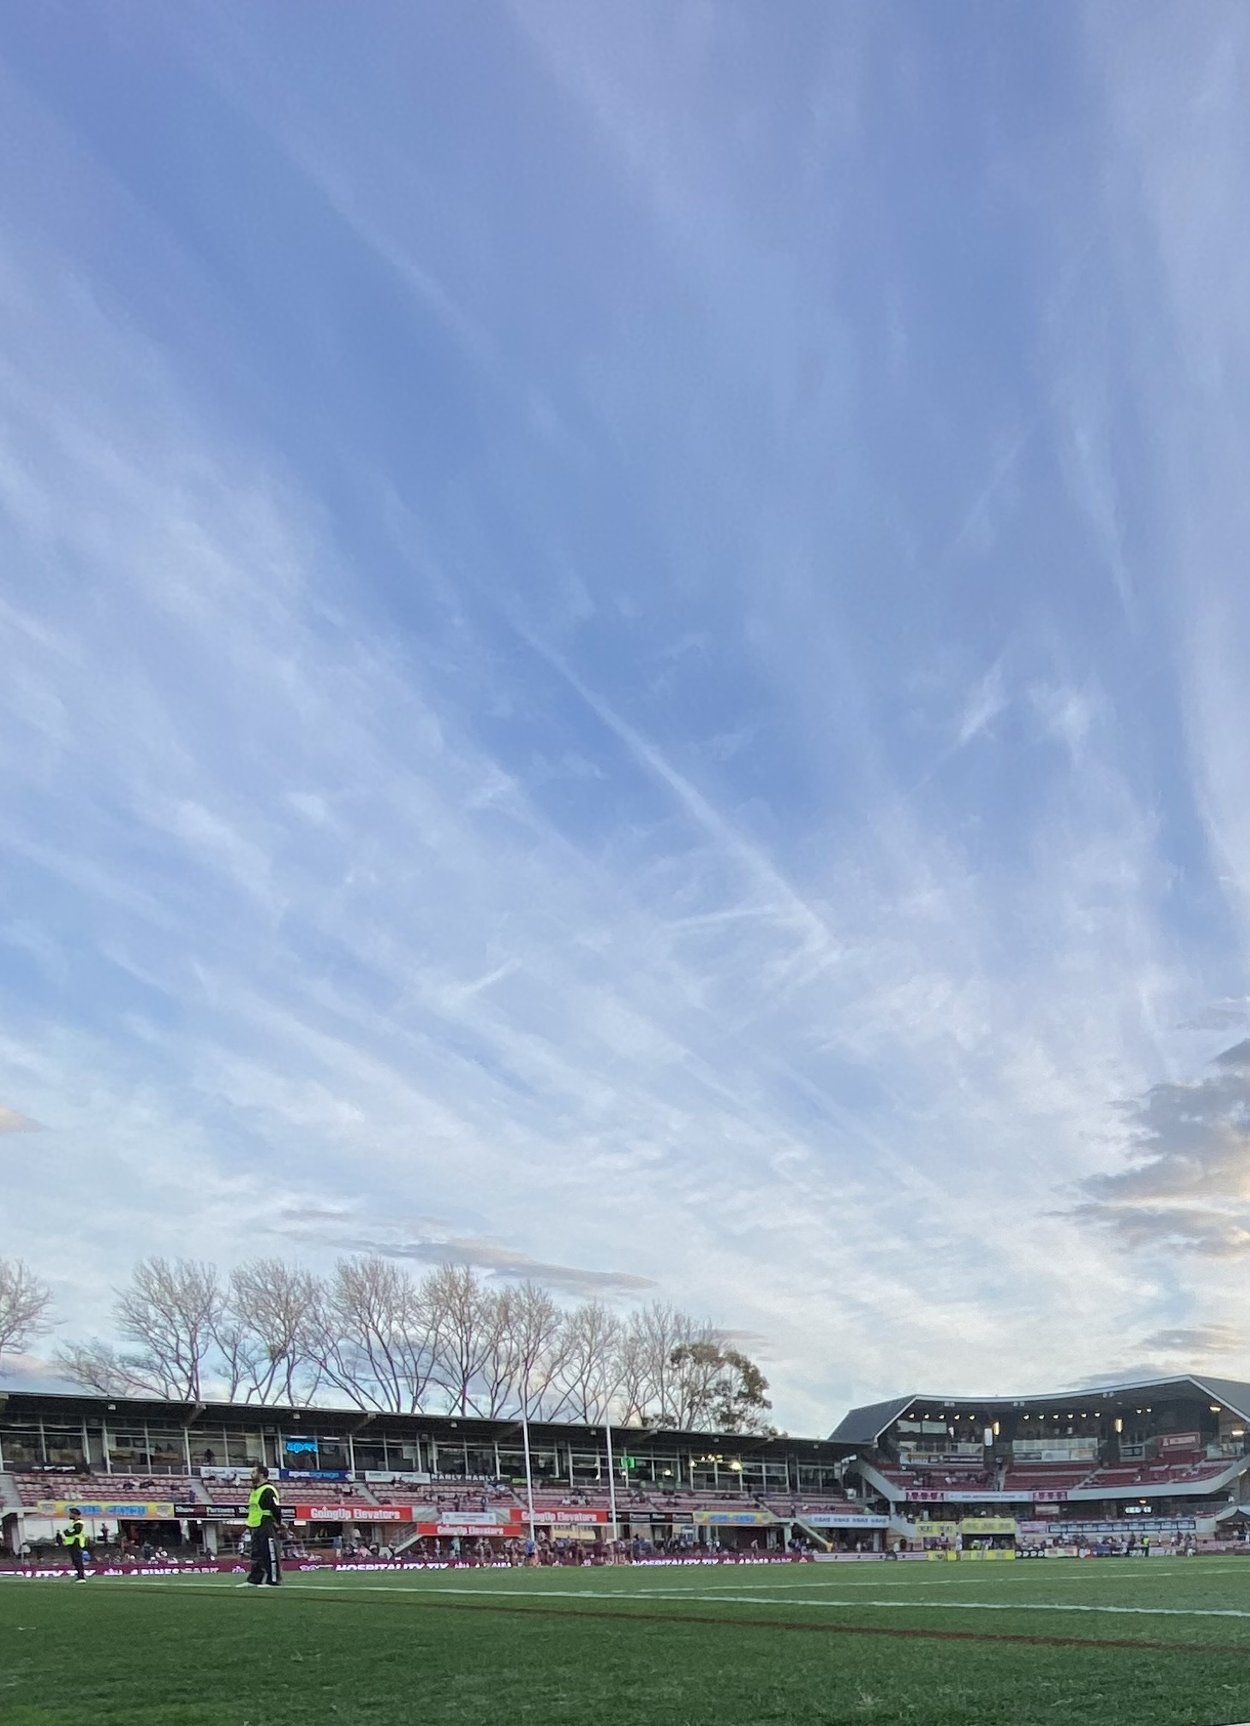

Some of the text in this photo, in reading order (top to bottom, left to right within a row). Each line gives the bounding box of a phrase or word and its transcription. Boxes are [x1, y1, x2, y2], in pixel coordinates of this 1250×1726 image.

[311, 1506, 401, 1520] GoingUp Elevators
[557, 1511, 597, 1522] Elevators
